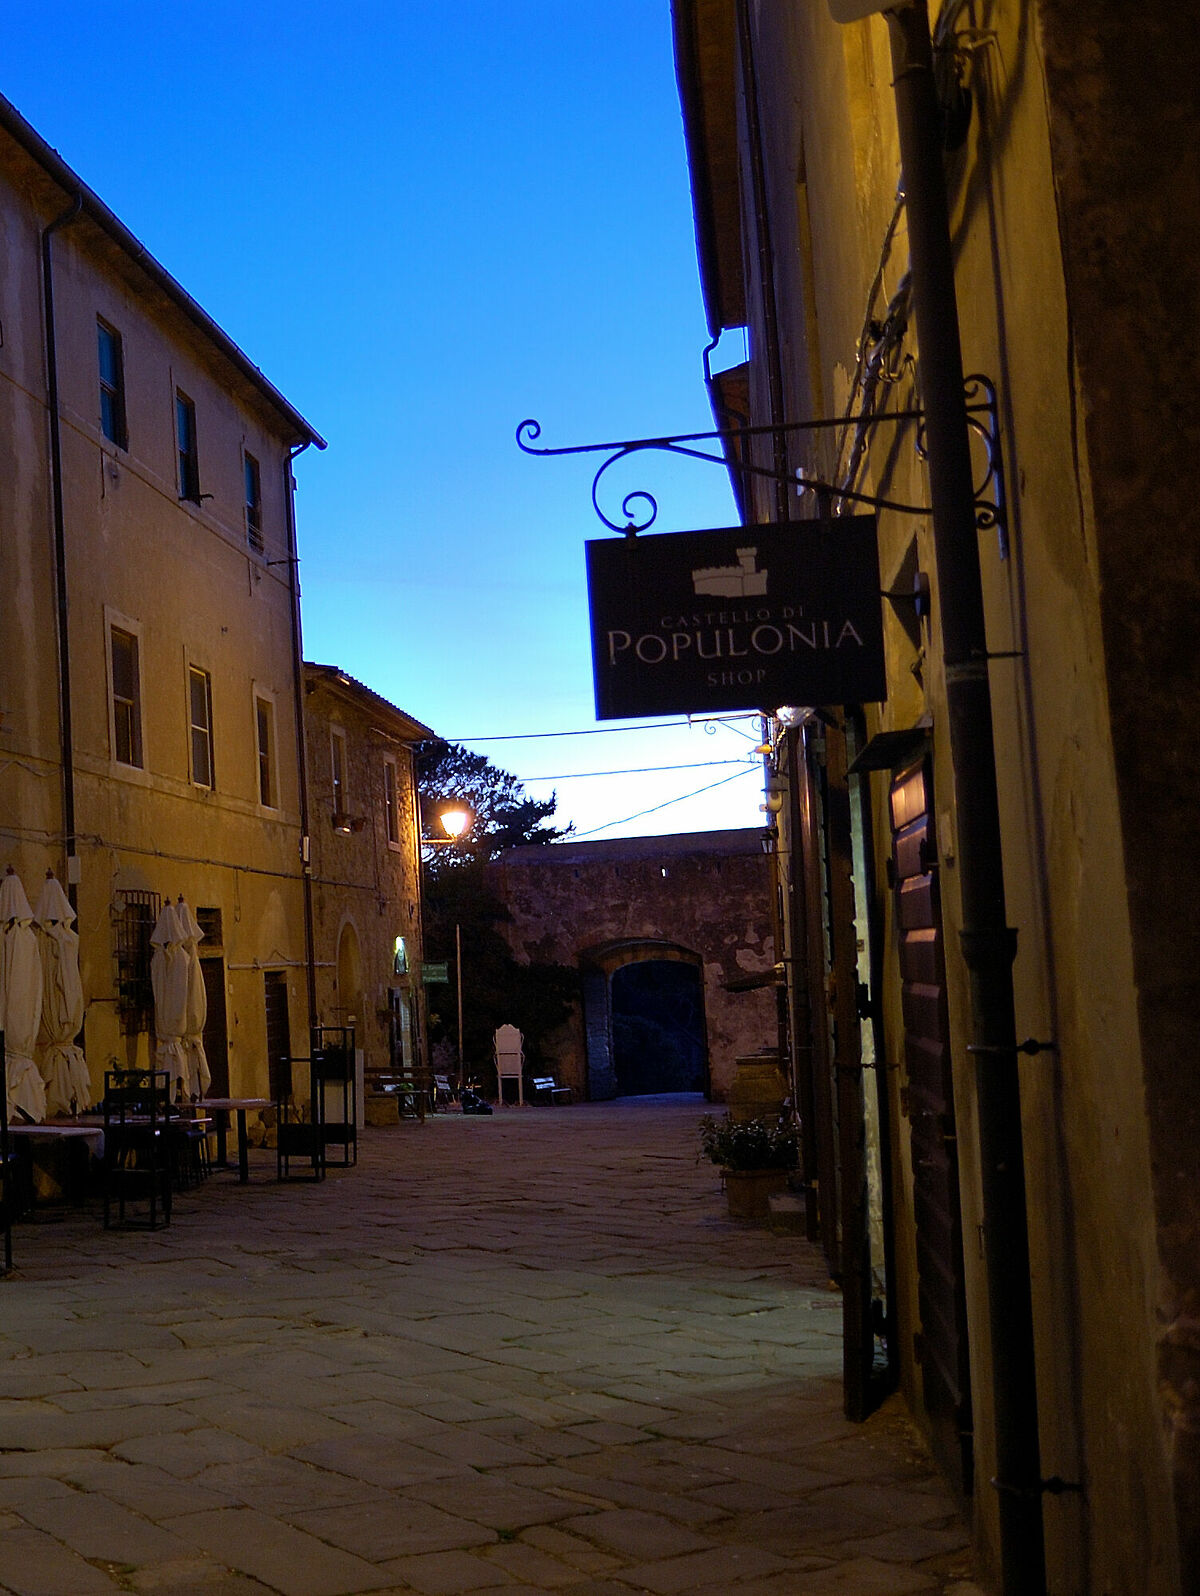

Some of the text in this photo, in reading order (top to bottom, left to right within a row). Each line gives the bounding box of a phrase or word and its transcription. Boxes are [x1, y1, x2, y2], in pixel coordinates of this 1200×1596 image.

[661, 606, 804, 629] CASTELLO DI
[607, 619, 864, 666] POPULONIA
[707, 670, 767, 688] SHOP
